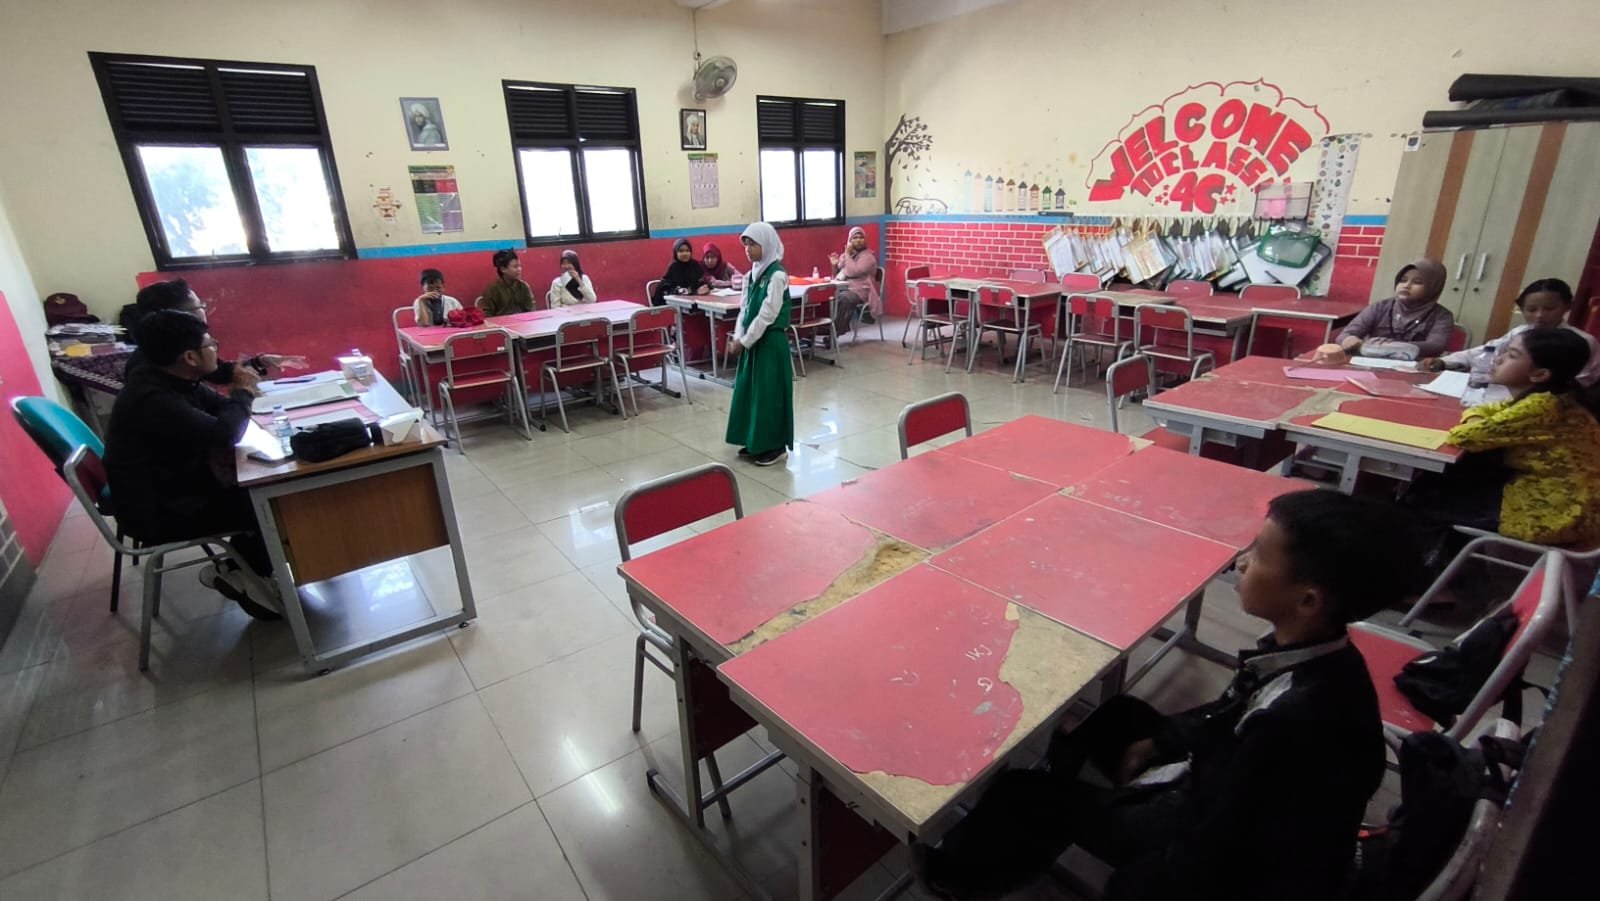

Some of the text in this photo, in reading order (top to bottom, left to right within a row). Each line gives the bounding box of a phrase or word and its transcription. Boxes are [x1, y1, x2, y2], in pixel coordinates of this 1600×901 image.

[1088, 98, 1312, 201] WELCOME
[1130, 161, 1165, 198] TO
[1169, 171, 1226, 214] 4C
